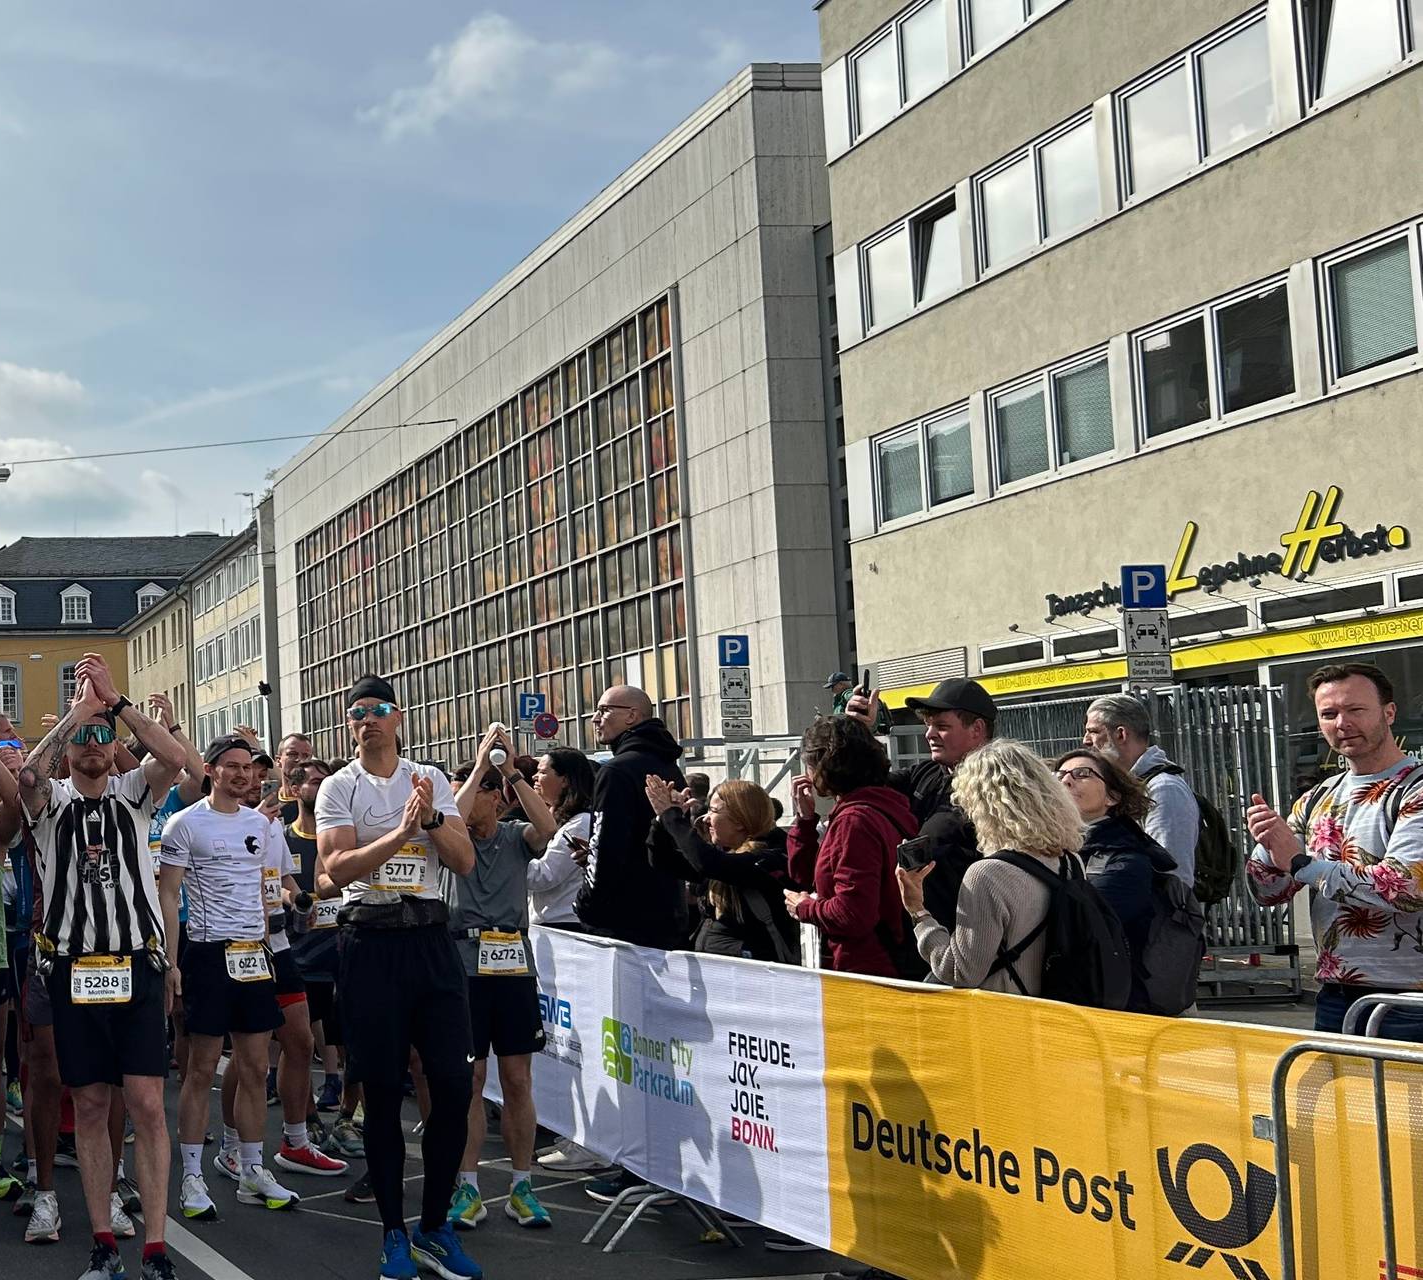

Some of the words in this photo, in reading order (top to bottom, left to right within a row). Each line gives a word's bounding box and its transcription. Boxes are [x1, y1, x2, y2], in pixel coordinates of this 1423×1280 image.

[1131, 571, 1156, 603] P
[725, 639, 742, 662] P
[525, 696, 540, 716] P
[385, 863, 416, 876] 5717
[490, 948, 517, 961] 6272
[84, 976, 120, 988] 5288
[632, 1029, 666, 1063] Bonner
[669, 1036, 693, 1076] City
[728, 1031, 796, 1070] FREUDE.
[633, 1056, 694, 1107] Parkraum
[728, 1061, 761, 1090] JOY.
[730, 1089, 769, 1121] JOIE.
[731, 1116, 779, 1154] BONN.
[851, 1101, 1021, 1195] Deutsche
[1033, 1146, 1137, 1232] Post
